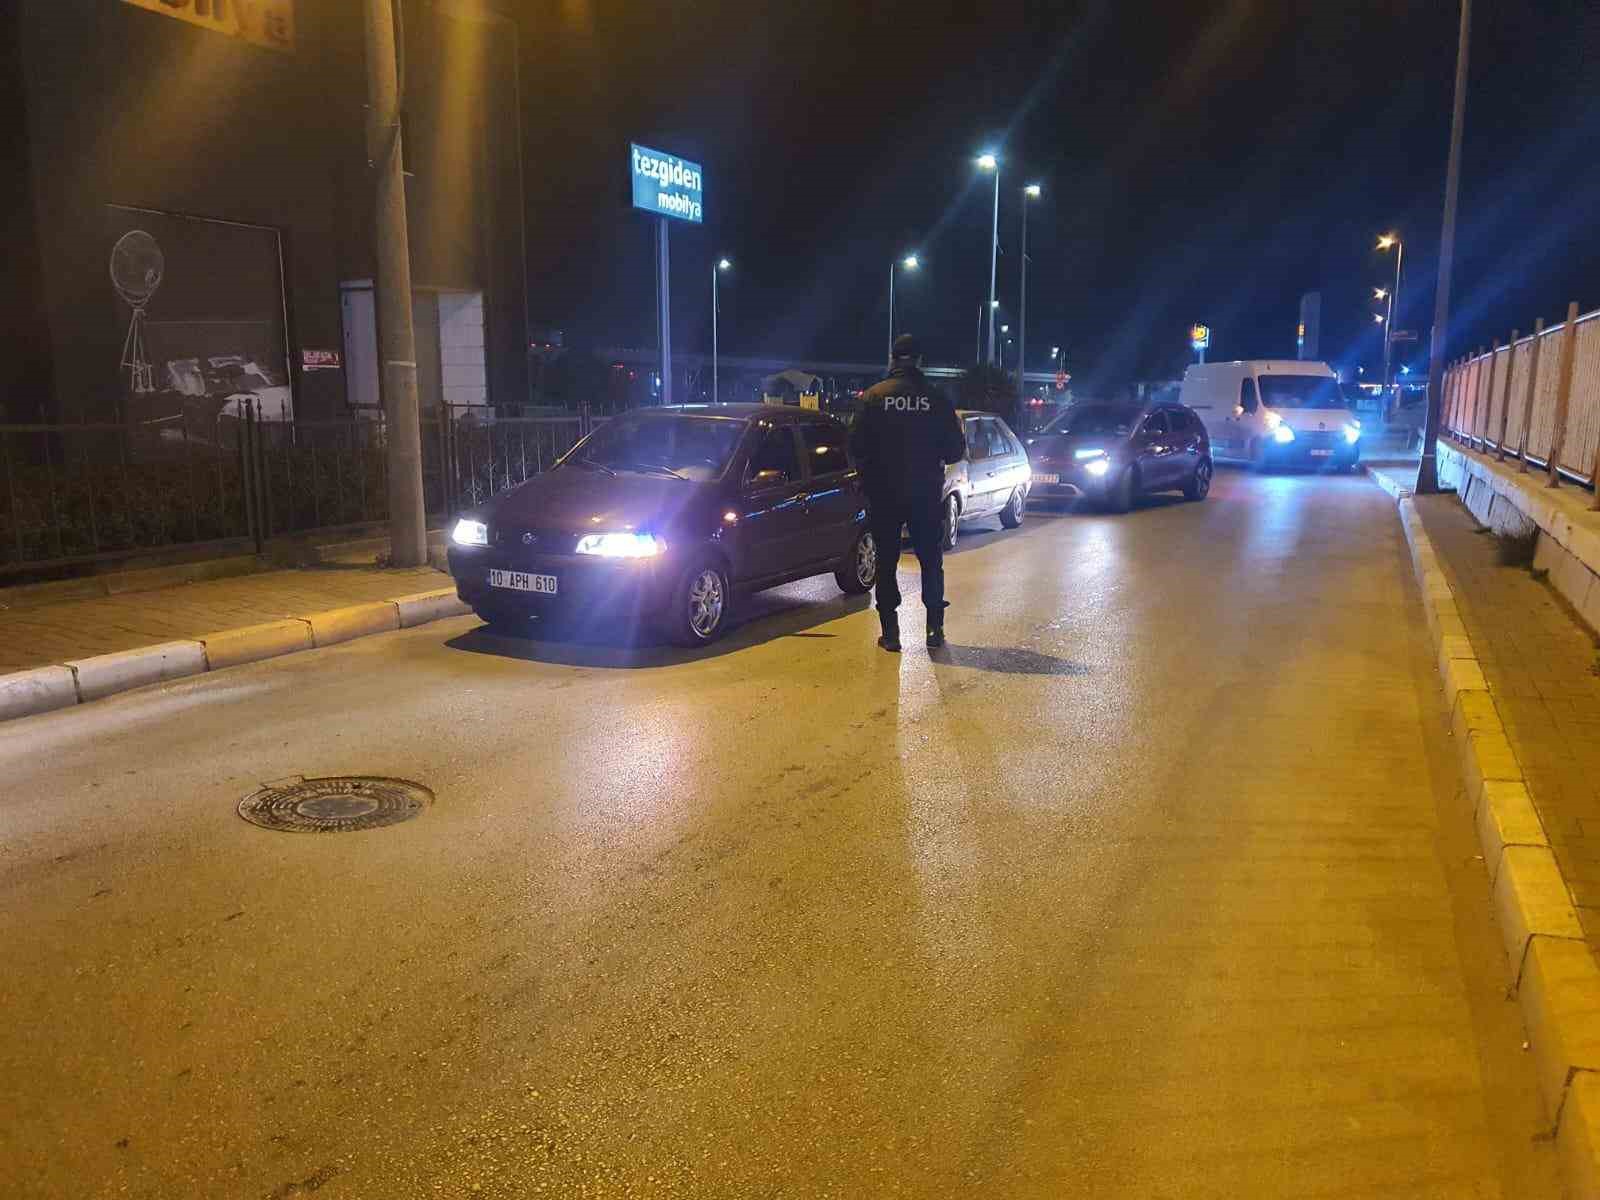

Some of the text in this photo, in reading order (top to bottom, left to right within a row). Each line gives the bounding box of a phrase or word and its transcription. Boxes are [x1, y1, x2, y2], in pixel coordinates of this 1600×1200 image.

[633, 148, 702, 191] tezgiden
[658, 192, 702, 219] mobilya
[492, 570, 555, 592] 10 APH 610
